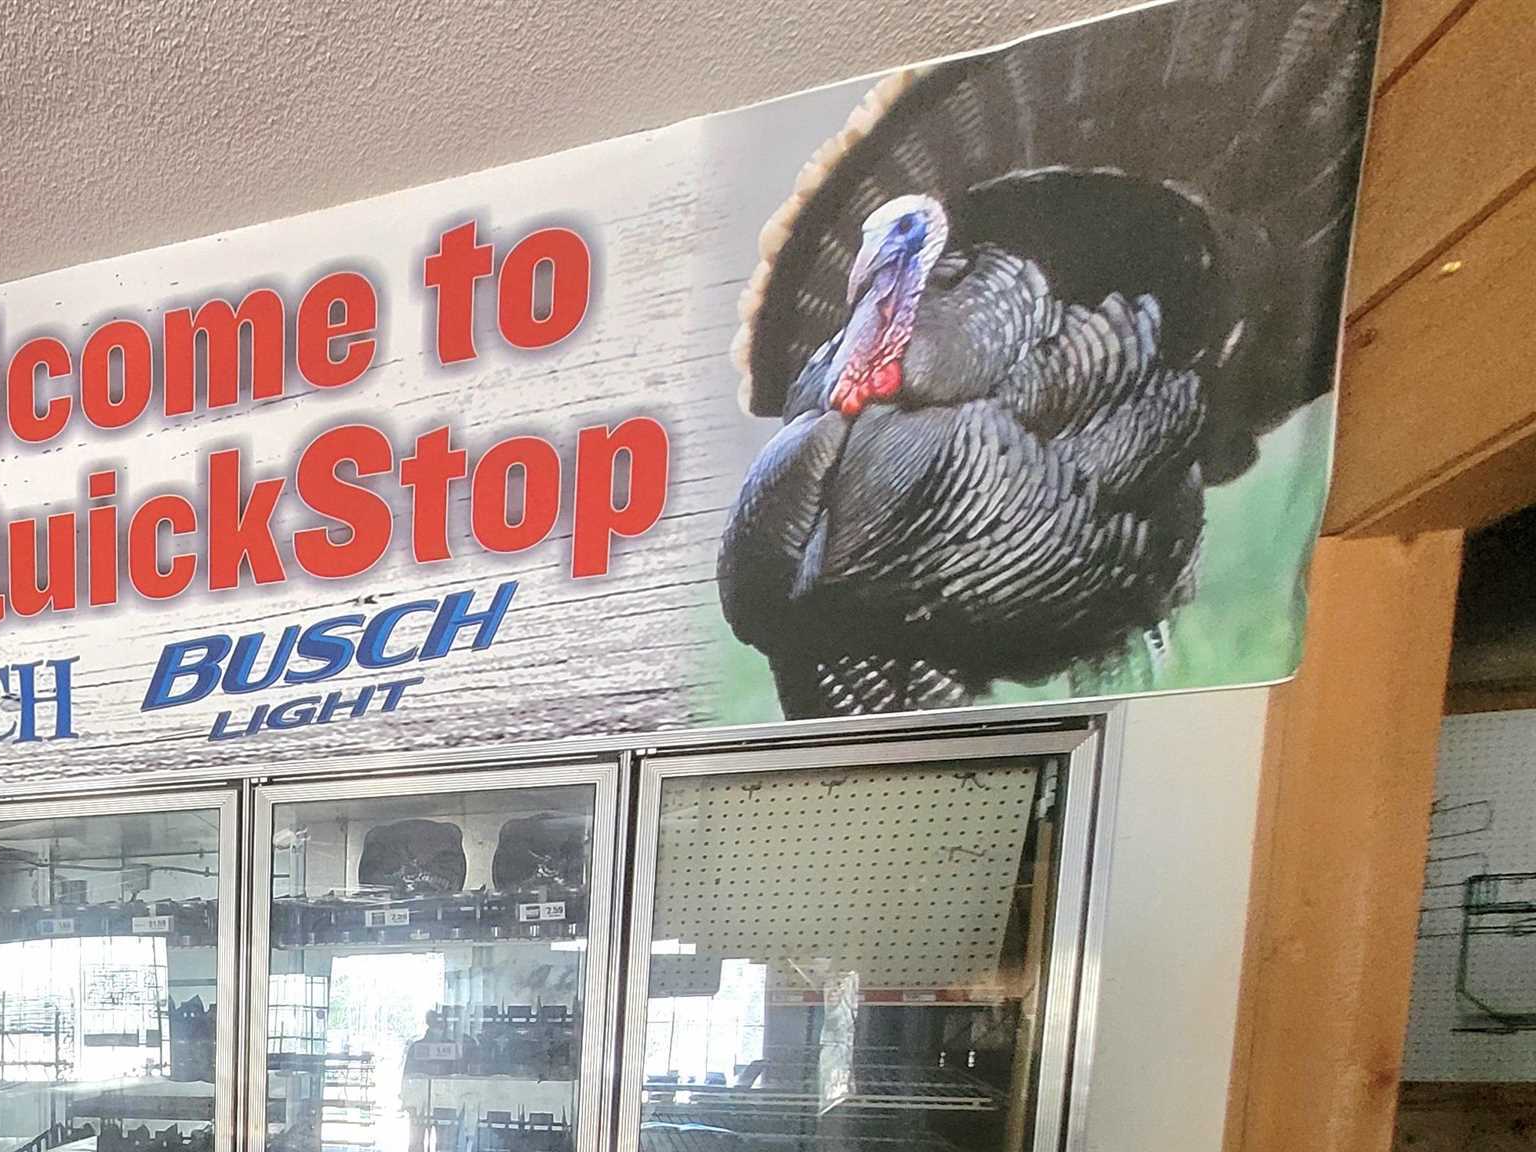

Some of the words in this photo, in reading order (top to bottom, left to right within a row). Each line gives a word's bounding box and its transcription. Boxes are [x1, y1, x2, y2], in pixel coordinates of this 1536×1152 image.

[424, 220, 591, 365] to
[140, 581, 519, 712] BUSCH
[207, 678, 422, 742] LIGHT
